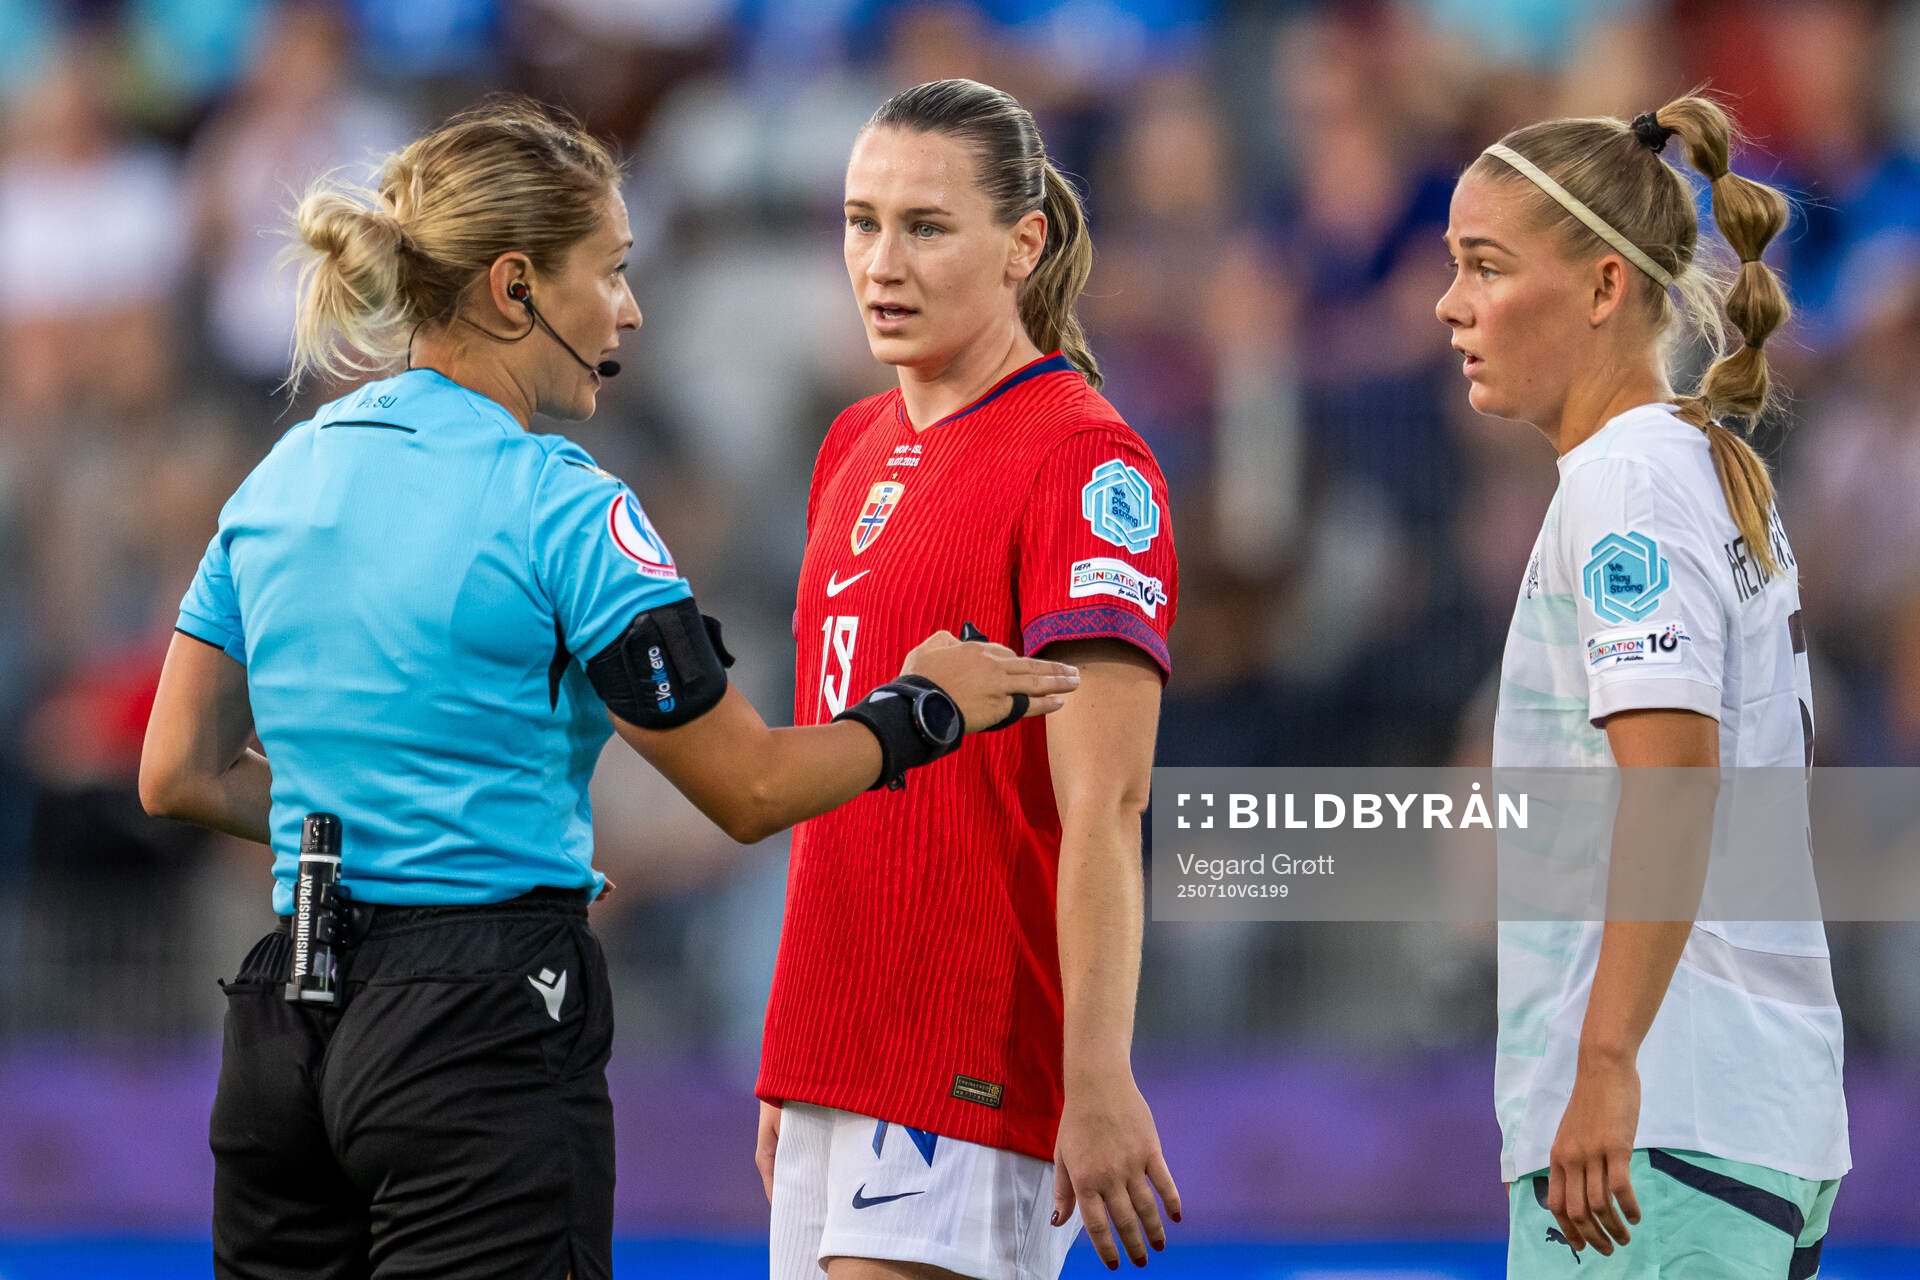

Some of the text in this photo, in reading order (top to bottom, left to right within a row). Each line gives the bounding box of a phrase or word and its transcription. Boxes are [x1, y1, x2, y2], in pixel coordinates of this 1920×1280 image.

[1112, 486, 1126, 499] We
[1112, 496, 1131, 514] Play
[1112, 506, 1138, 528] Strong
[1608, 562, 1624, 572] We
[1609, 574, 1631, 586] Play
[1610, 584, 1643, 594] Strong
[1646, 633, 1678, 653] 10
[816, 615, 859, 726] 19
[294, 873, 314, 977] VANISHINGSPRAY
